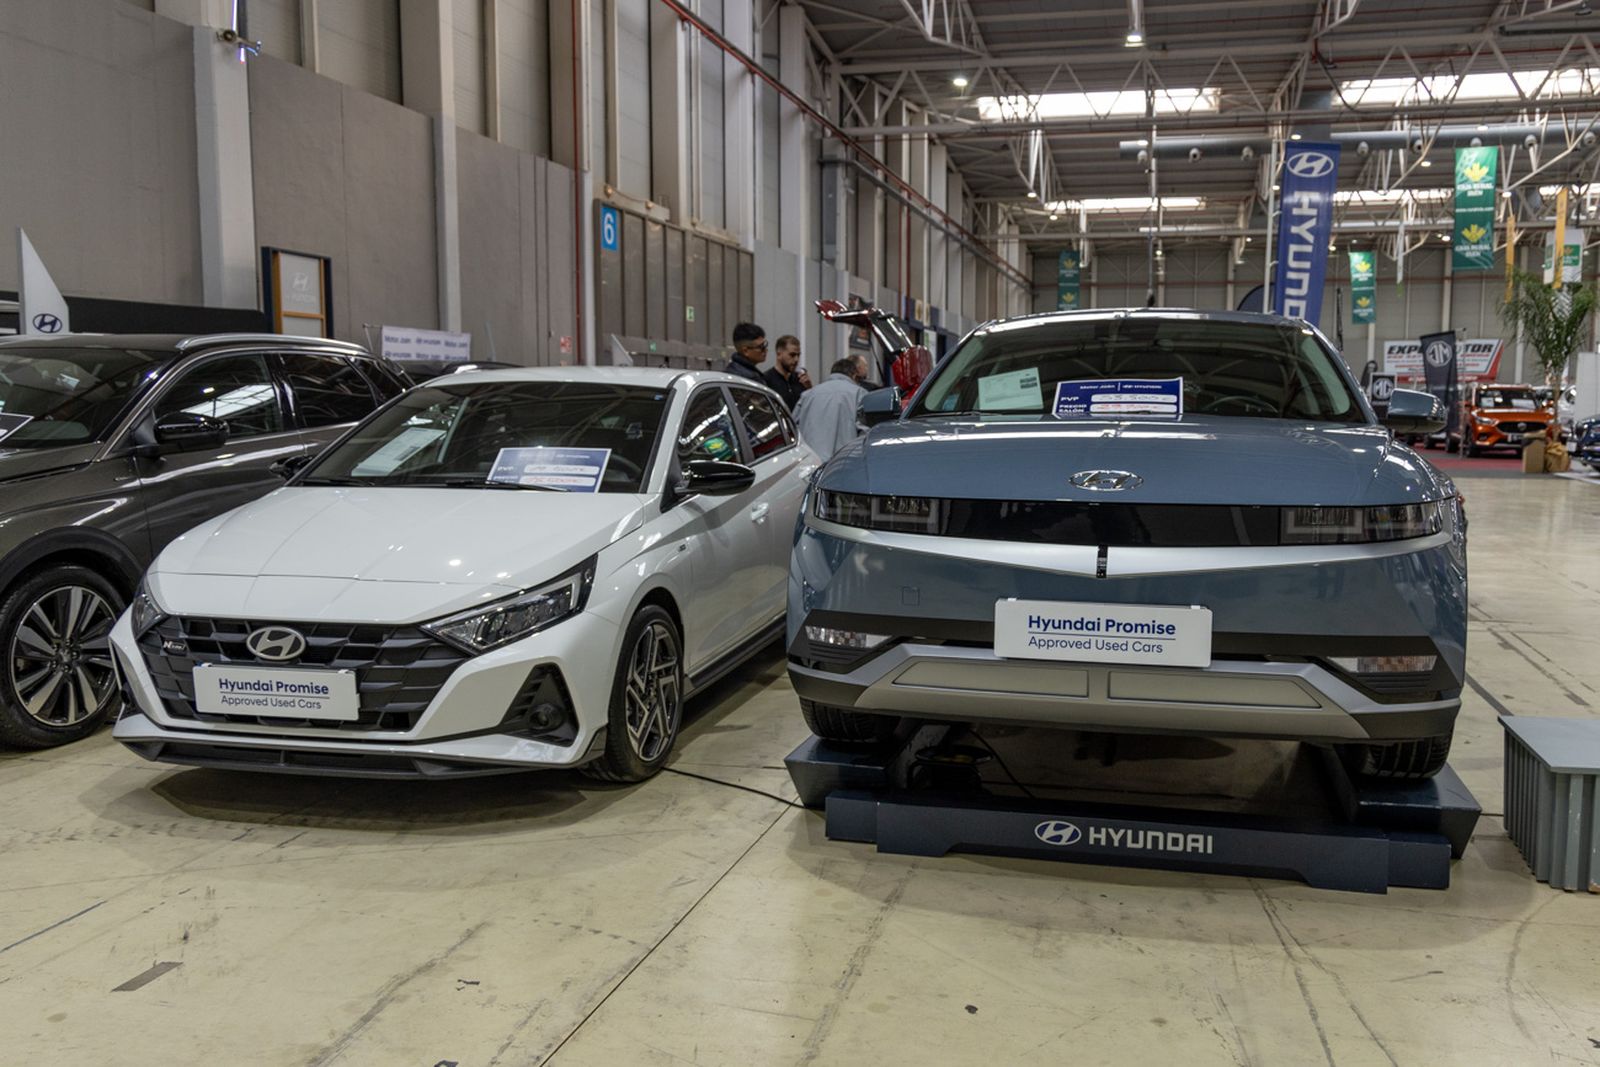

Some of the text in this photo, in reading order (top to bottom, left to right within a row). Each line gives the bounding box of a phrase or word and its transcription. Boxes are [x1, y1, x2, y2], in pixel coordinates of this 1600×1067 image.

[604, 212, 614, 245] 6
[1028, 615, 1176, 635] Hyundai Promise
[1028, 636, 1163, 653] Approved Used Cars
[219, 678, 329, 694] Hyundai Promise
[221, 695, 321, 709] Approved Used Cars
[1089, 826, 1213, 854] HYUNDAI
